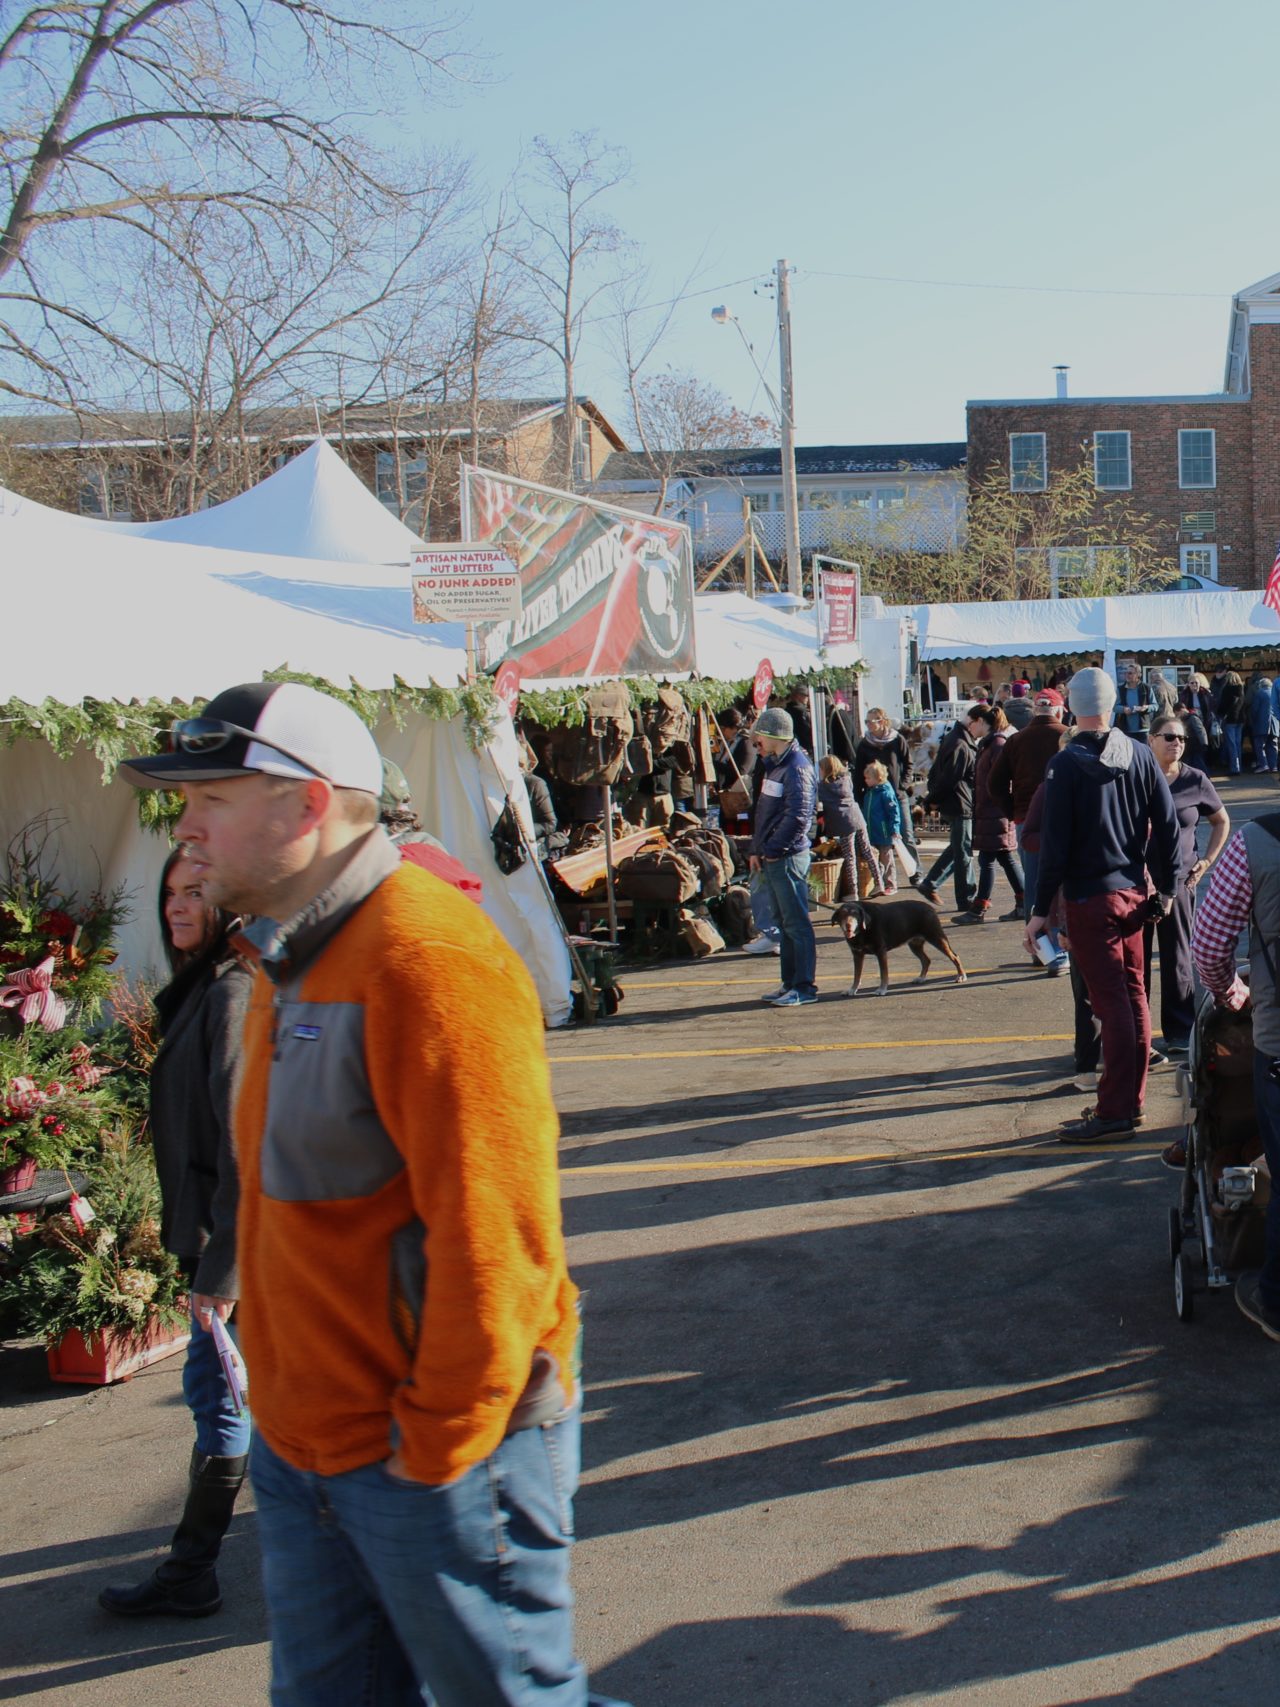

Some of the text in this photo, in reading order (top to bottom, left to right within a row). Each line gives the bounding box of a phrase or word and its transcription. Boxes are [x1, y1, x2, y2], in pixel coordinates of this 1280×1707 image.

[415, 552, 506, 563] ARTISAN NATURAL
[430, 563, 494, 573] NUT BUTTERS
[418, 577, 516, 588] NO JUNK ADDED!
[512, 585, 559, 647] RIVER
[558, 524, 626, 614] TRADING
